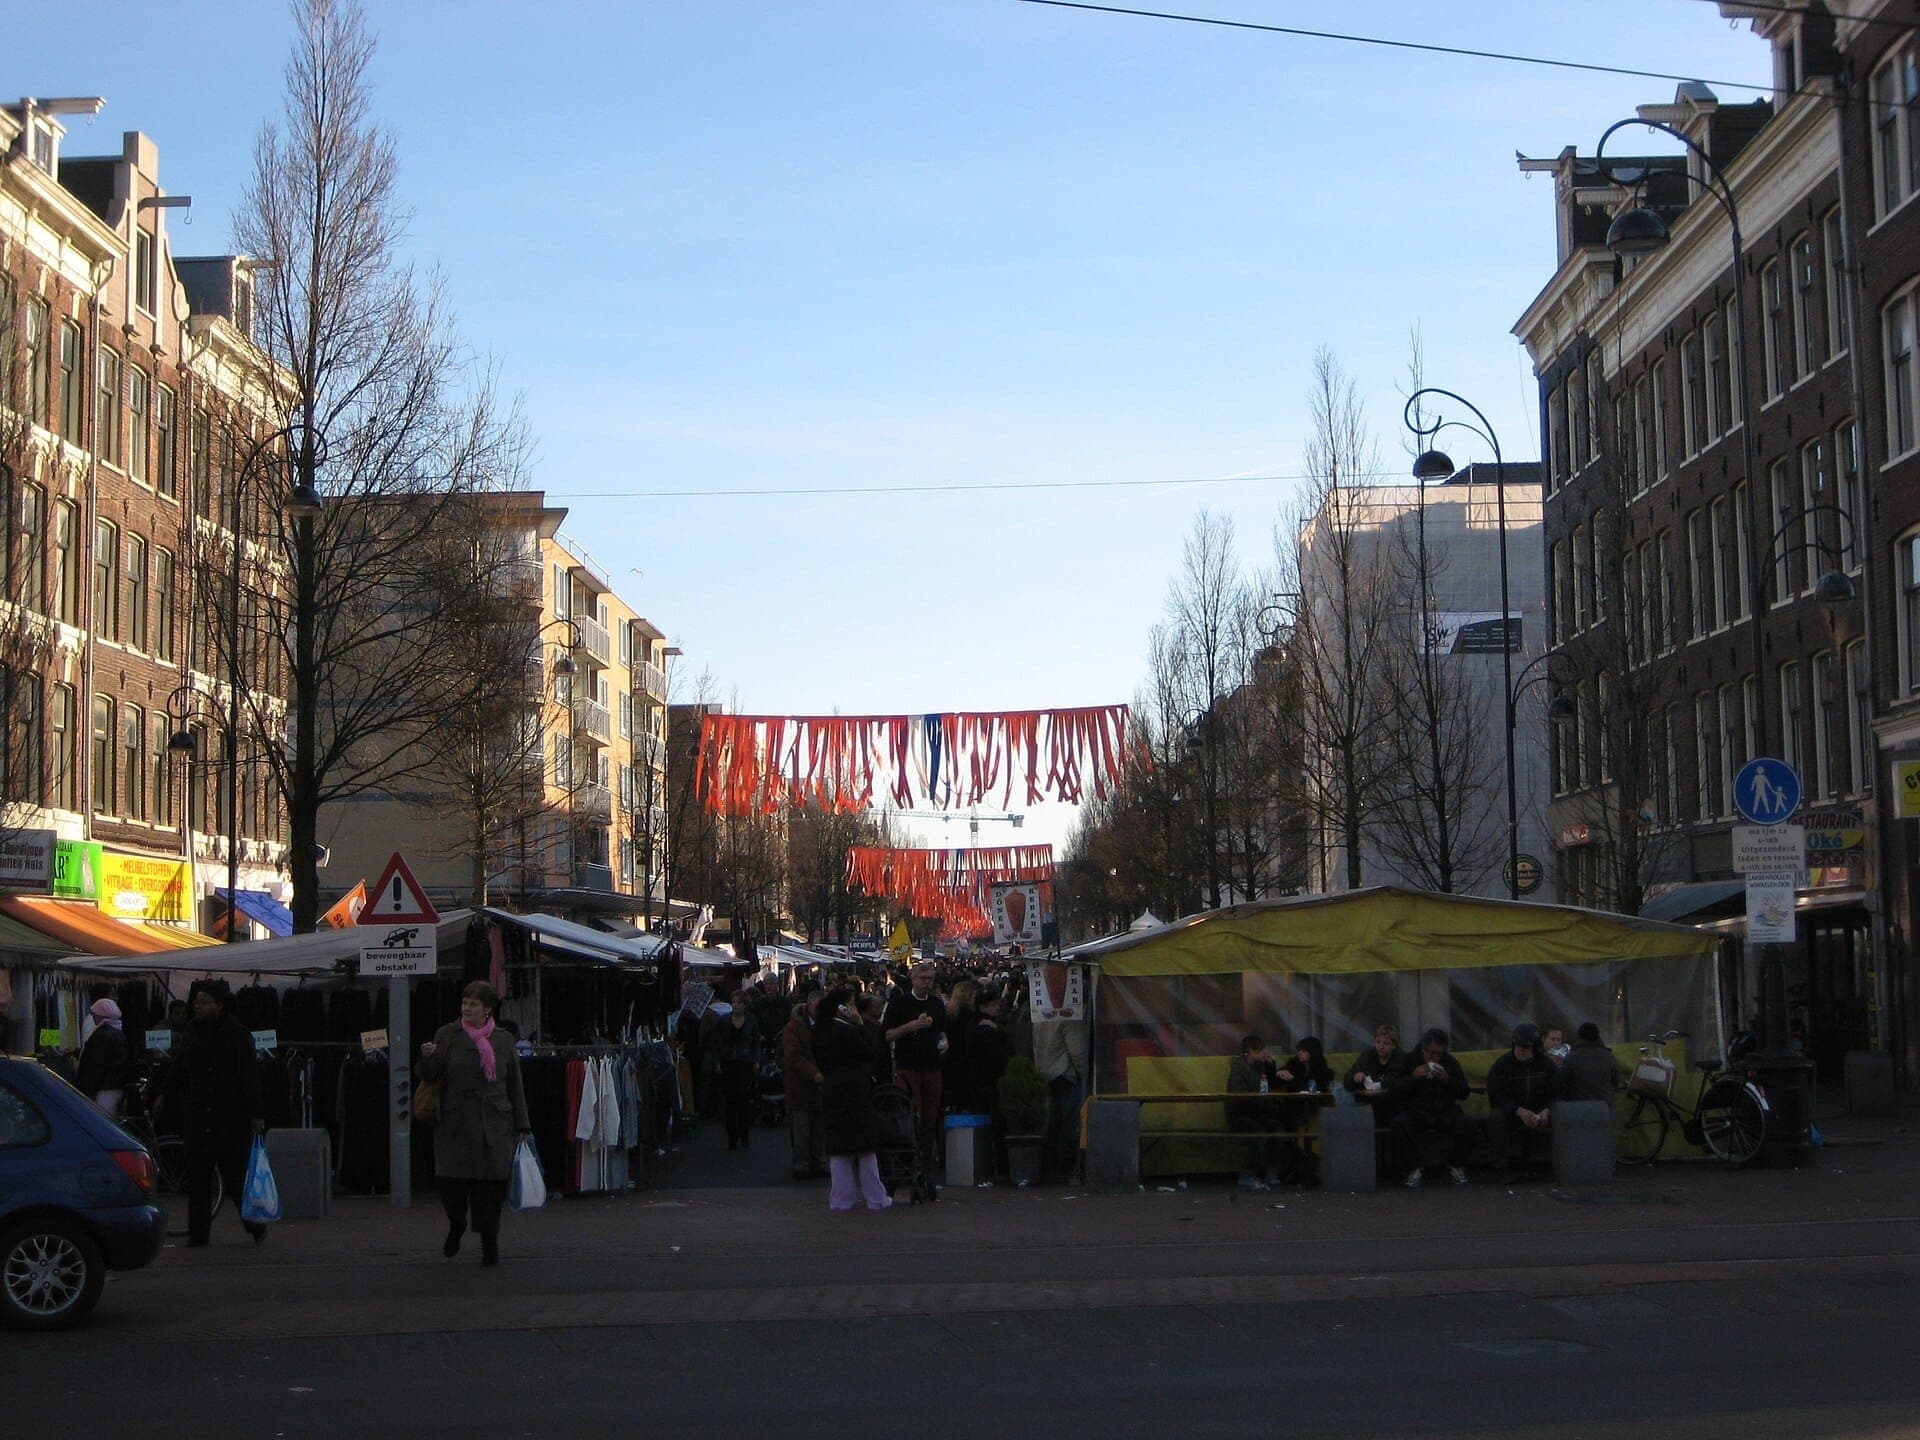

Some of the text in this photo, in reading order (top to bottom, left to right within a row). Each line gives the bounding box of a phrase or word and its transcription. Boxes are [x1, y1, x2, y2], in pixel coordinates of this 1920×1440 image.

[1807, 831, 1843, 849] Oké
[1741, 845, 1796, 854] Uitgezonderd
[123, 860, 172, 877] MEUBELSTOFFEN
[106, 873, 133, 890] VITRAGE
[1028, 888, 1037, 927] KEBAB
[366, 952, 427, 962] beweegbaar
[375, 963, 417, 972] obstakel
